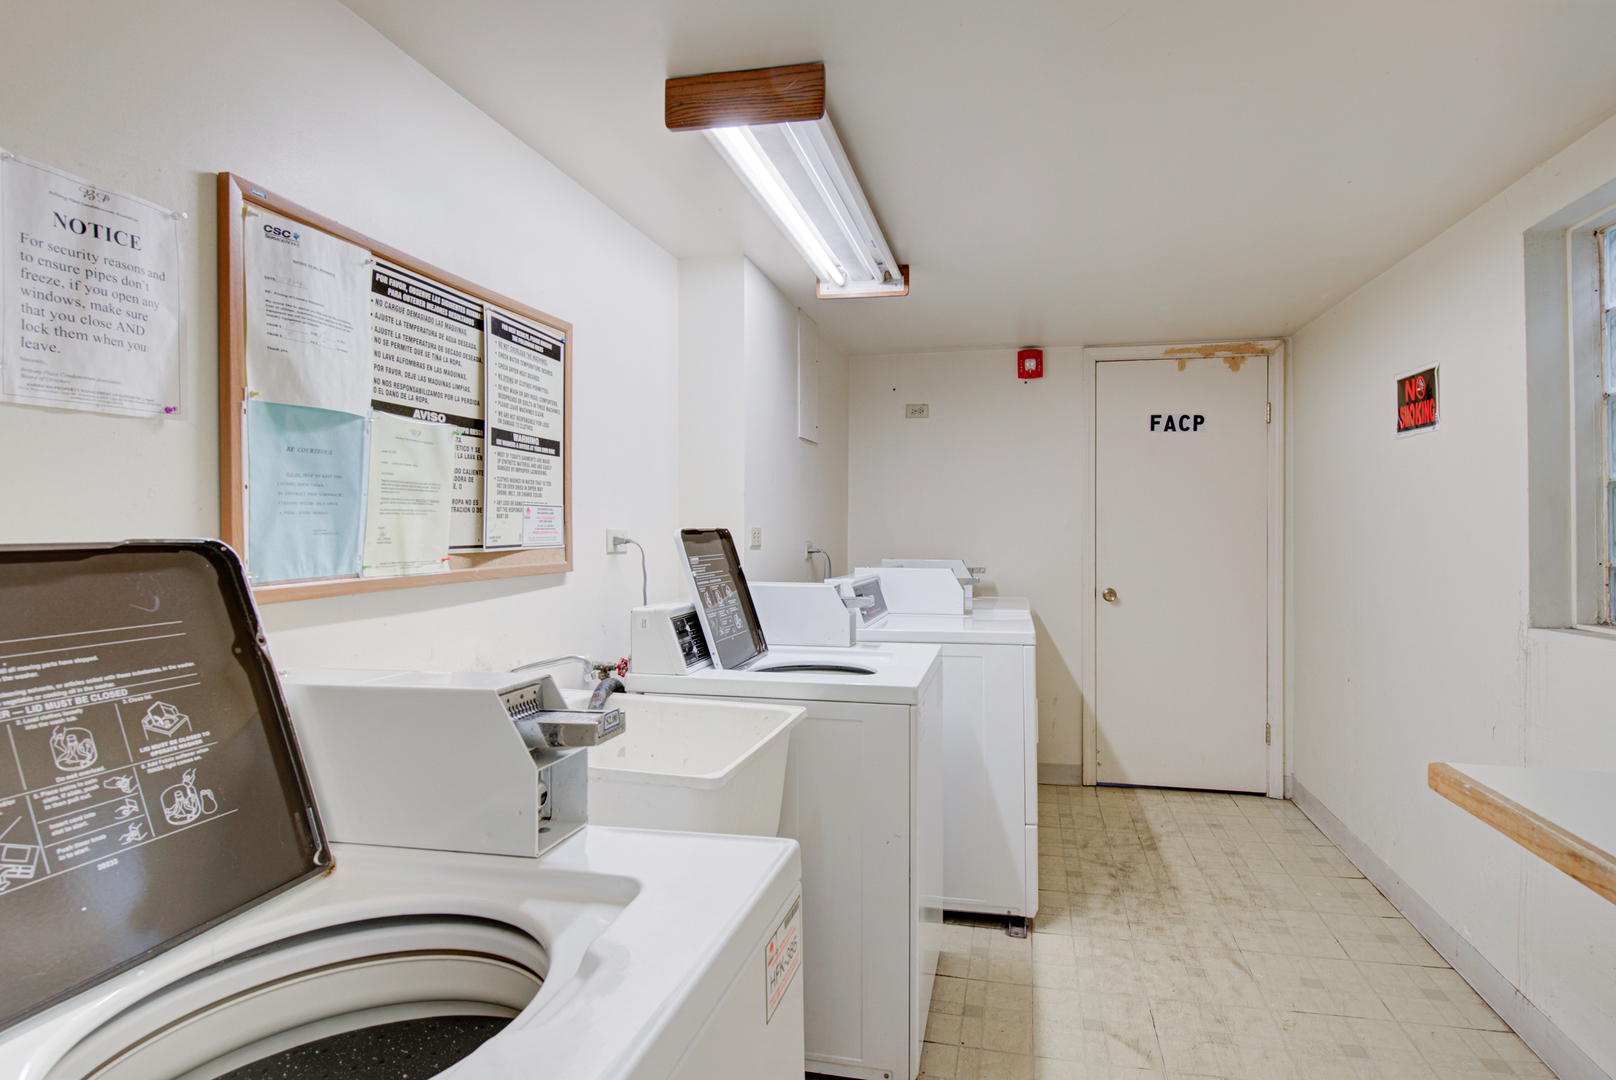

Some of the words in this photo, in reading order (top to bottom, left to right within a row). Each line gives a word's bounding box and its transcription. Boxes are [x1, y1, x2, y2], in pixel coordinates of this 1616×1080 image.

[53, 210, 141, 251] NOTICE
[264, 224, 291, 238] CSC
[20, 232, 44, 248] For
[47, 242, 99, 264] security
[103, 256, 145, 275] reasons
[148, 269, 165, 281] and
[20, 251, 33, 262] to
[37, 257, 80, 274] ensure
[85, 267, 117, 283] pipes
[121, 275, 149, 292] don't
[20, 267, 65, 289] freeze,
[70, 278, 82, 290] if
[85, 284, 108, 297] you
[112, 291, 139, 304] open
[142, 298, 159, 311] any
[20, 287, 85, 310] windows,
[90, 301, 122, 315] make
[126, 309, 148, 322] sure
[21, 303, 45, 317] that
[50, 311, 75, 323] you
[80, 315, 112, 329] close
[116, 322, 145, 336] AND
[385, 302, 405, 314] CARGUE
[407, 309, 434, 324] DEMASIADO
[435, 319, 443, 327] LAS
[445, 322, 467, 336] MAQUINAS.
[21, 319, 49, 335] lock
[54, 326, 88, 341] them
[92, 334, 124, 348] when
[127, 341, 147, 352] you
[21, 336, 60, 353] leave.
[374, 326, 393, 337] AJUSTE
[395, 332, 401, 340] LA
[403, 334, 436, 350] TEMPERATURA
[445, 347, 462, 358] SECADO
[463, 353, 483, 364] DESEADA.
[375, 312, 394, 325] AJUSTE
[396, 319, 402, 327] LA
[404, 321, 437, 338] TEMPERATURA
[439, 332, 444, 340] DE
[446, 334, 457, 344] AGUA
[458, 338, 478, 350] DESEADA.
[374, 336, 381, 344] NO
[391, 341, 412, 353] PERMITE
[414, 348, 423, 356] QUE
[450, 358, 462, 367] ROPA.
[374, 350, 381, 358] NO
[382, 352, 394, 361] LAVE
[396, 356, 425, 369] ALFOMBRAS
[434, 366, 442, 374] LAS
[443, 369, 467, 380] MAQUINAS.
[373, 377, 380, 385] NO
[382, 379, 392, 387] NOS
[461, 398, 480, 406] PERDIDA
[374, 364, 384, 372] POR
[386, 366, 403, 376] FAVOR,
[404, 371, 416, 379] DEJE
[418, 374, 426, 382] LAS
[428, 377, 451, 388] MAQUINAS
[452, 382, 471, 393] LIMPIAS.
[1405, 376, 1426, 402] NO
[415, 396, 429, 404] ROPA.
[1400, 398, 1435, 428] SMOKING
[412, 409, 446, 423] AVISO
[1150, 414, 1205, 432] FACP
[297, 447, 333, 455] COURTEOUS
[24, 704, 43, 714] LID
[44, 698, 74, 710] MUST
[74, 695, 89, 704] BE
[90, 688, 128, 702] CLOSED
[149, 745, 178, 757] OPERATE
[178, 739, 203, 749] WASHER
[150, 741, 168, 750] MUST
[178, 733, 201, 743] CLOSED
